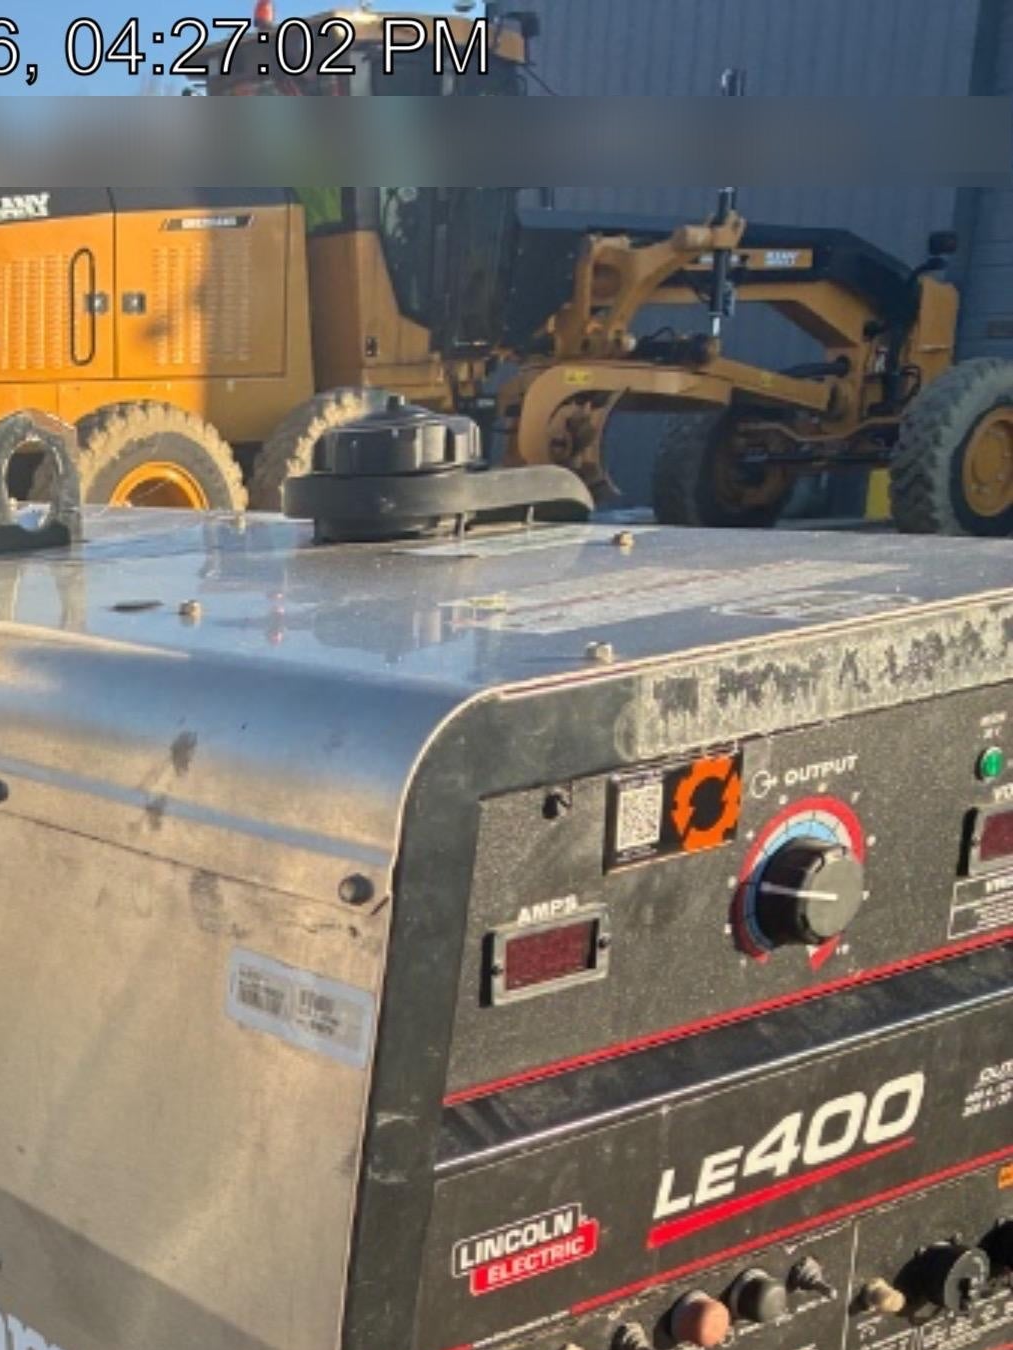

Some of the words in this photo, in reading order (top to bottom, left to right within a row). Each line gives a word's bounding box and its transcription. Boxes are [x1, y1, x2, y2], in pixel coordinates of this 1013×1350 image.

[785, 756, 859, 786] OUTPUT
[517, 893, 578, 927] AMPS
[652, 1071, 926, 1220] LE400
[459, 1210, 574, 1271] LINCOLN
[488, 1236, 587, 1286] ELECTRIC
